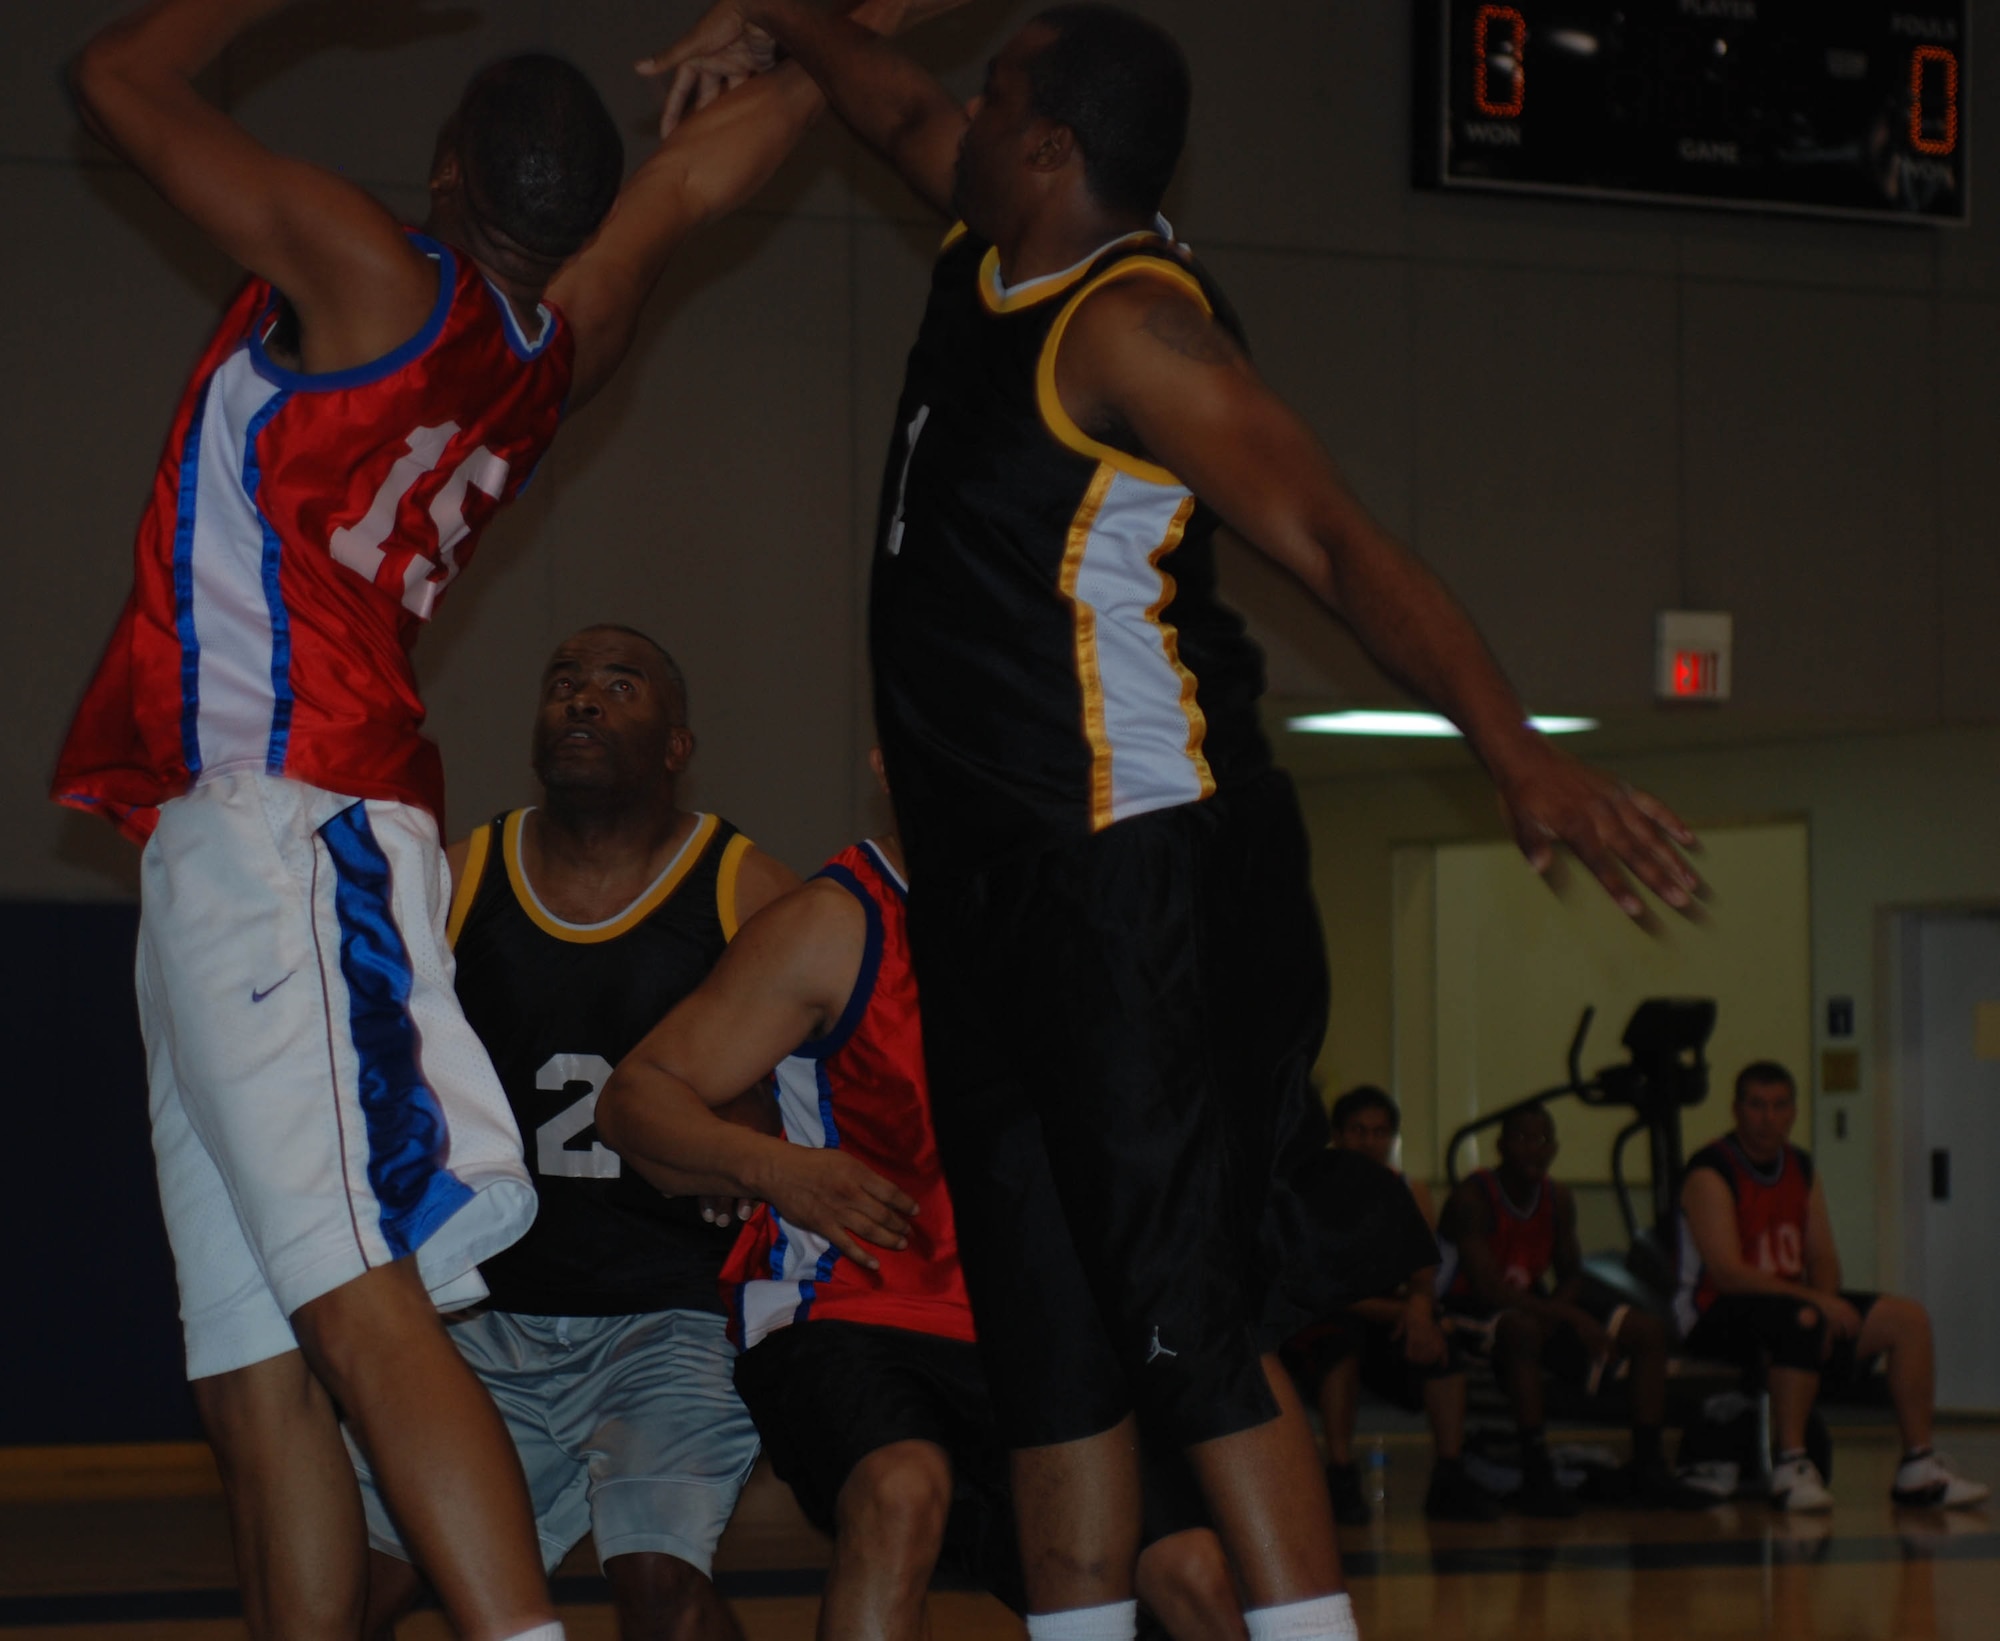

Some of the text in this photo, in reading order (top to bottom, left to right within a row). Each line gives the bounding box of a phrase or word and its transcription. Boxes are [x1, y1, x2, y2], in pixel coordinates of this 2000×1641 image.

[1677, 0, 1758, 21] PLAYER
[1890, 12, 1957, 40] FOULS
[1473, 4, 1526, 118] 0
[1911, 45, 1958, 156] 0
[1464, 121, 1521, 145] WON
[1677, 137, 1740, 165] GAME
[329, 420, 510, 622] 15
[1676, 652, 1718, 693] EXIT
[1757, 1223, 1802, 1273] 10
